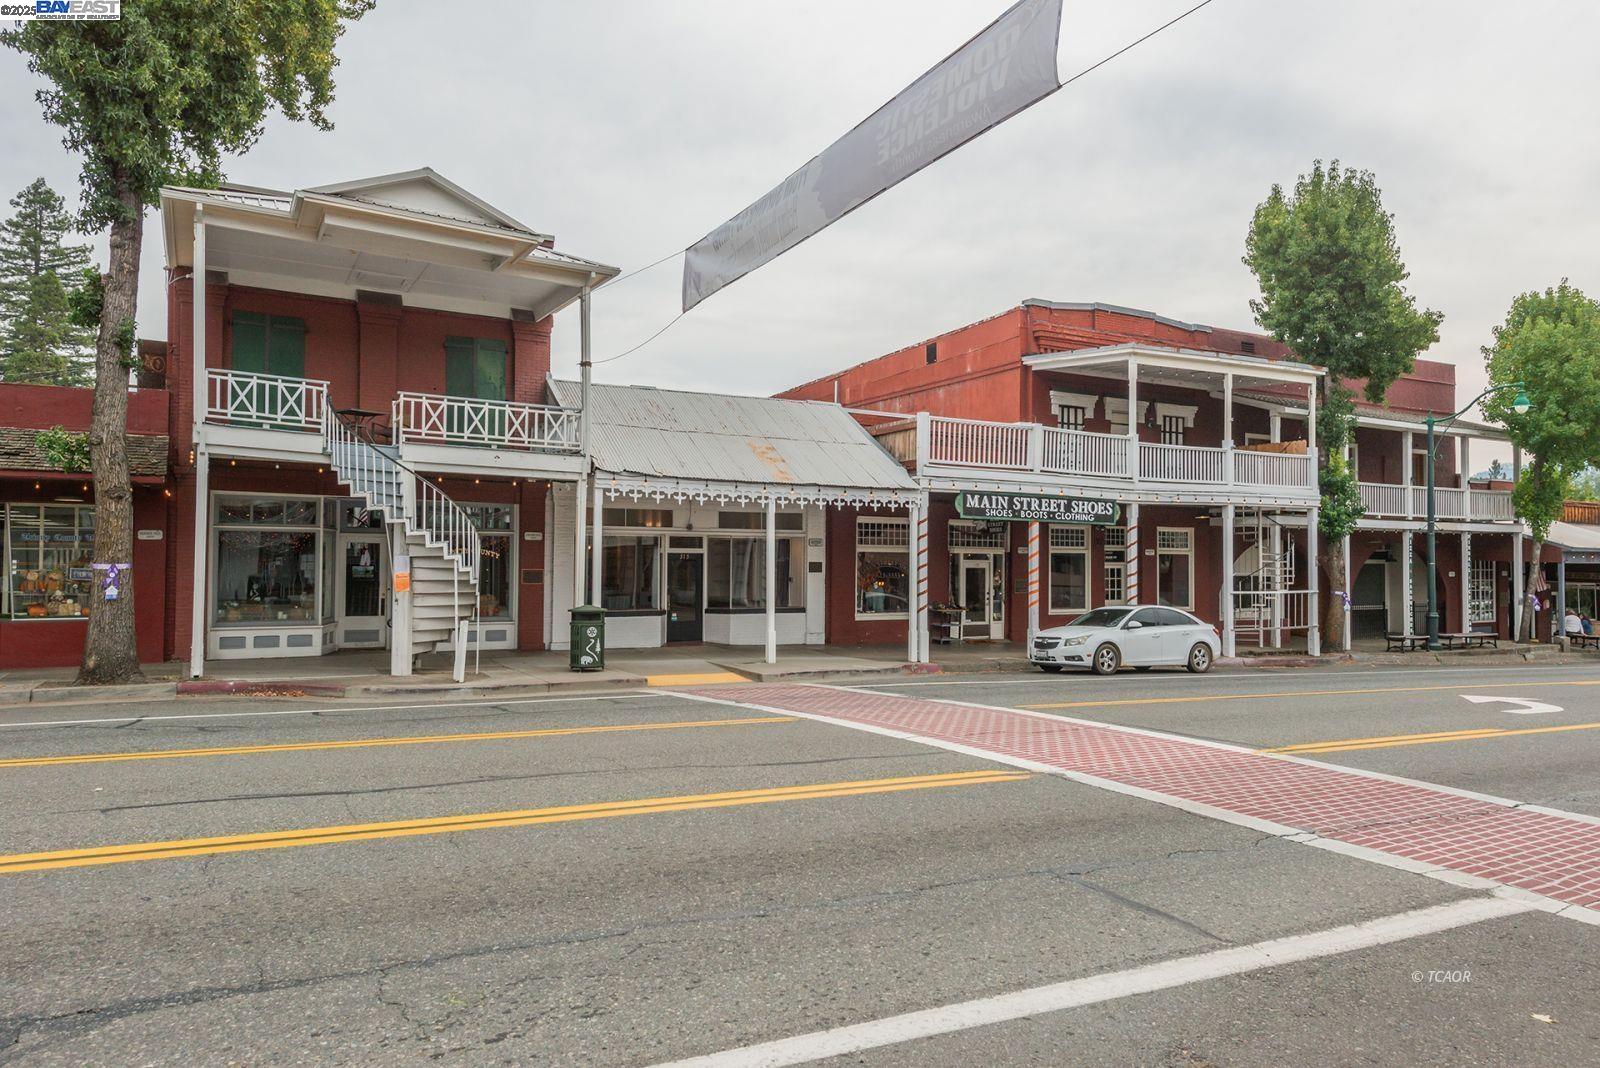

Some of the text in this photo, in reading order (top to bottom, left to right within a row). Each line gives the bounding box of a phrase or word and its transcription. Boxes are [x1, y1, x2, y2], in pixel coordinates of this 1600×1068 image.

[966, 494, 1113, 515] MAIN STREET SHOES
[985, 508, 1095, 521] SHOES BOOTS CLOTHING
